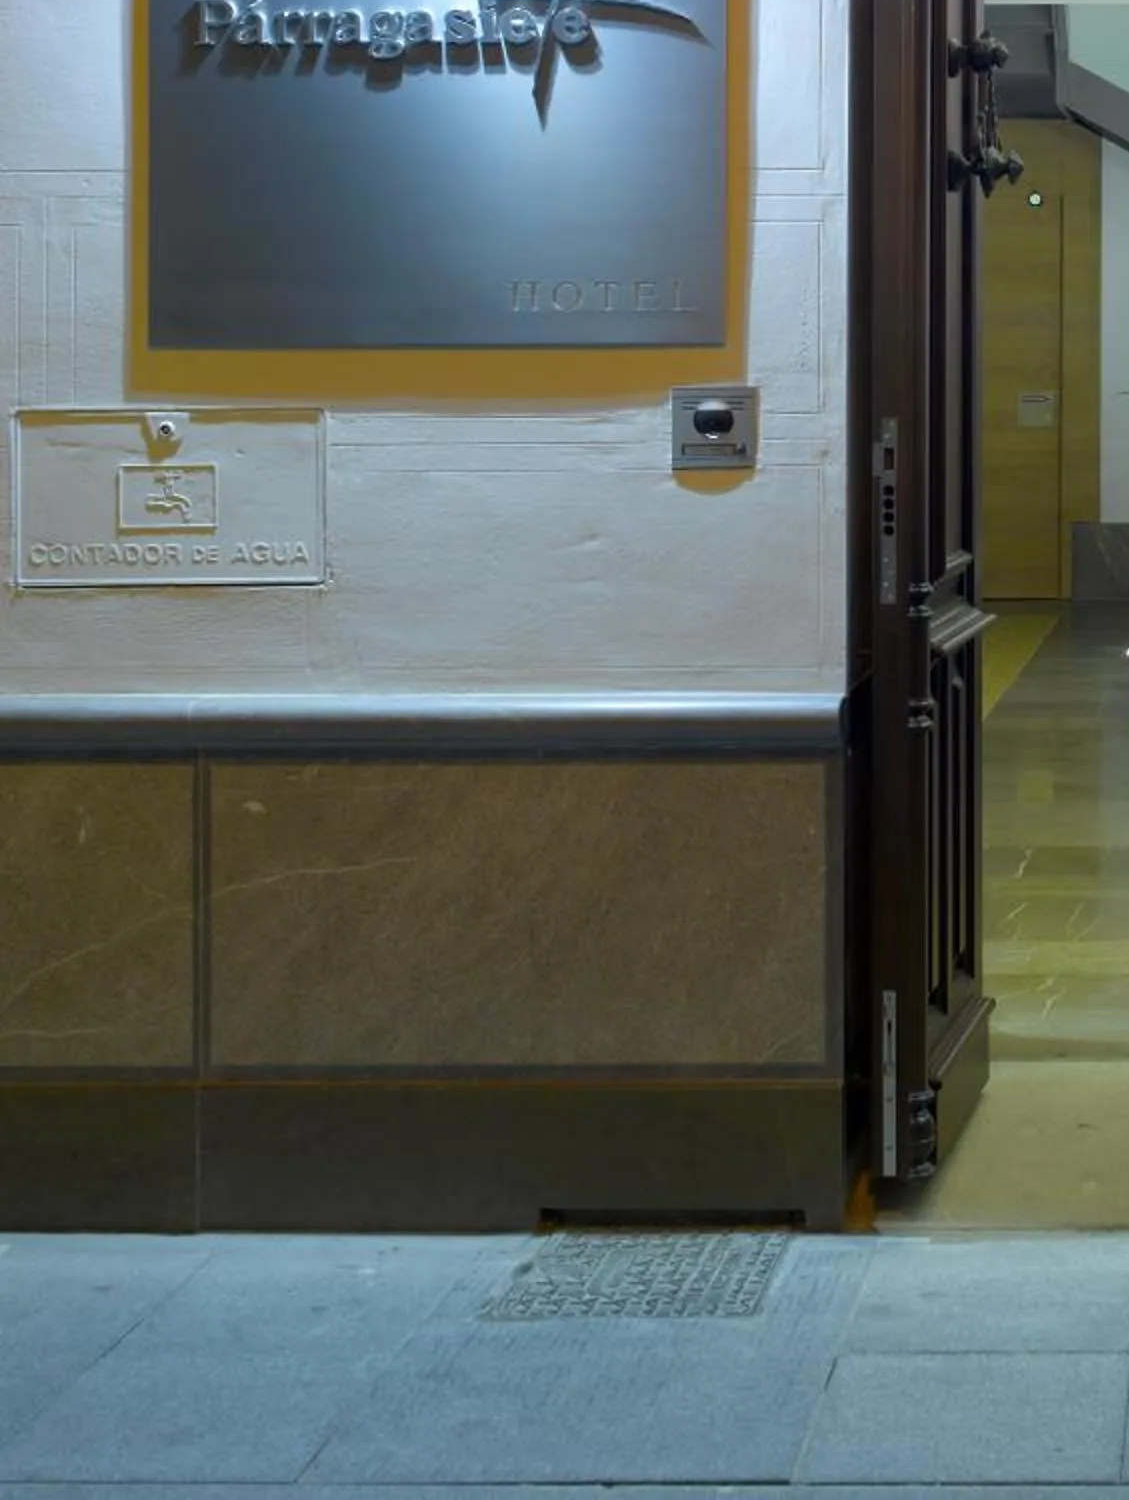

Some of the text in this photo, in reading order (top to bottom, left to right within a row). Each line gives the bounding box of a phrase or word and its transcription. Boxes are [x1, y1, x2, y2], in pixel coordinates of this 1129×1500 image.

[508, 279, 699, 314] HOTEL
[28, 541, 310, 567] CONTADOR DE AGUA
